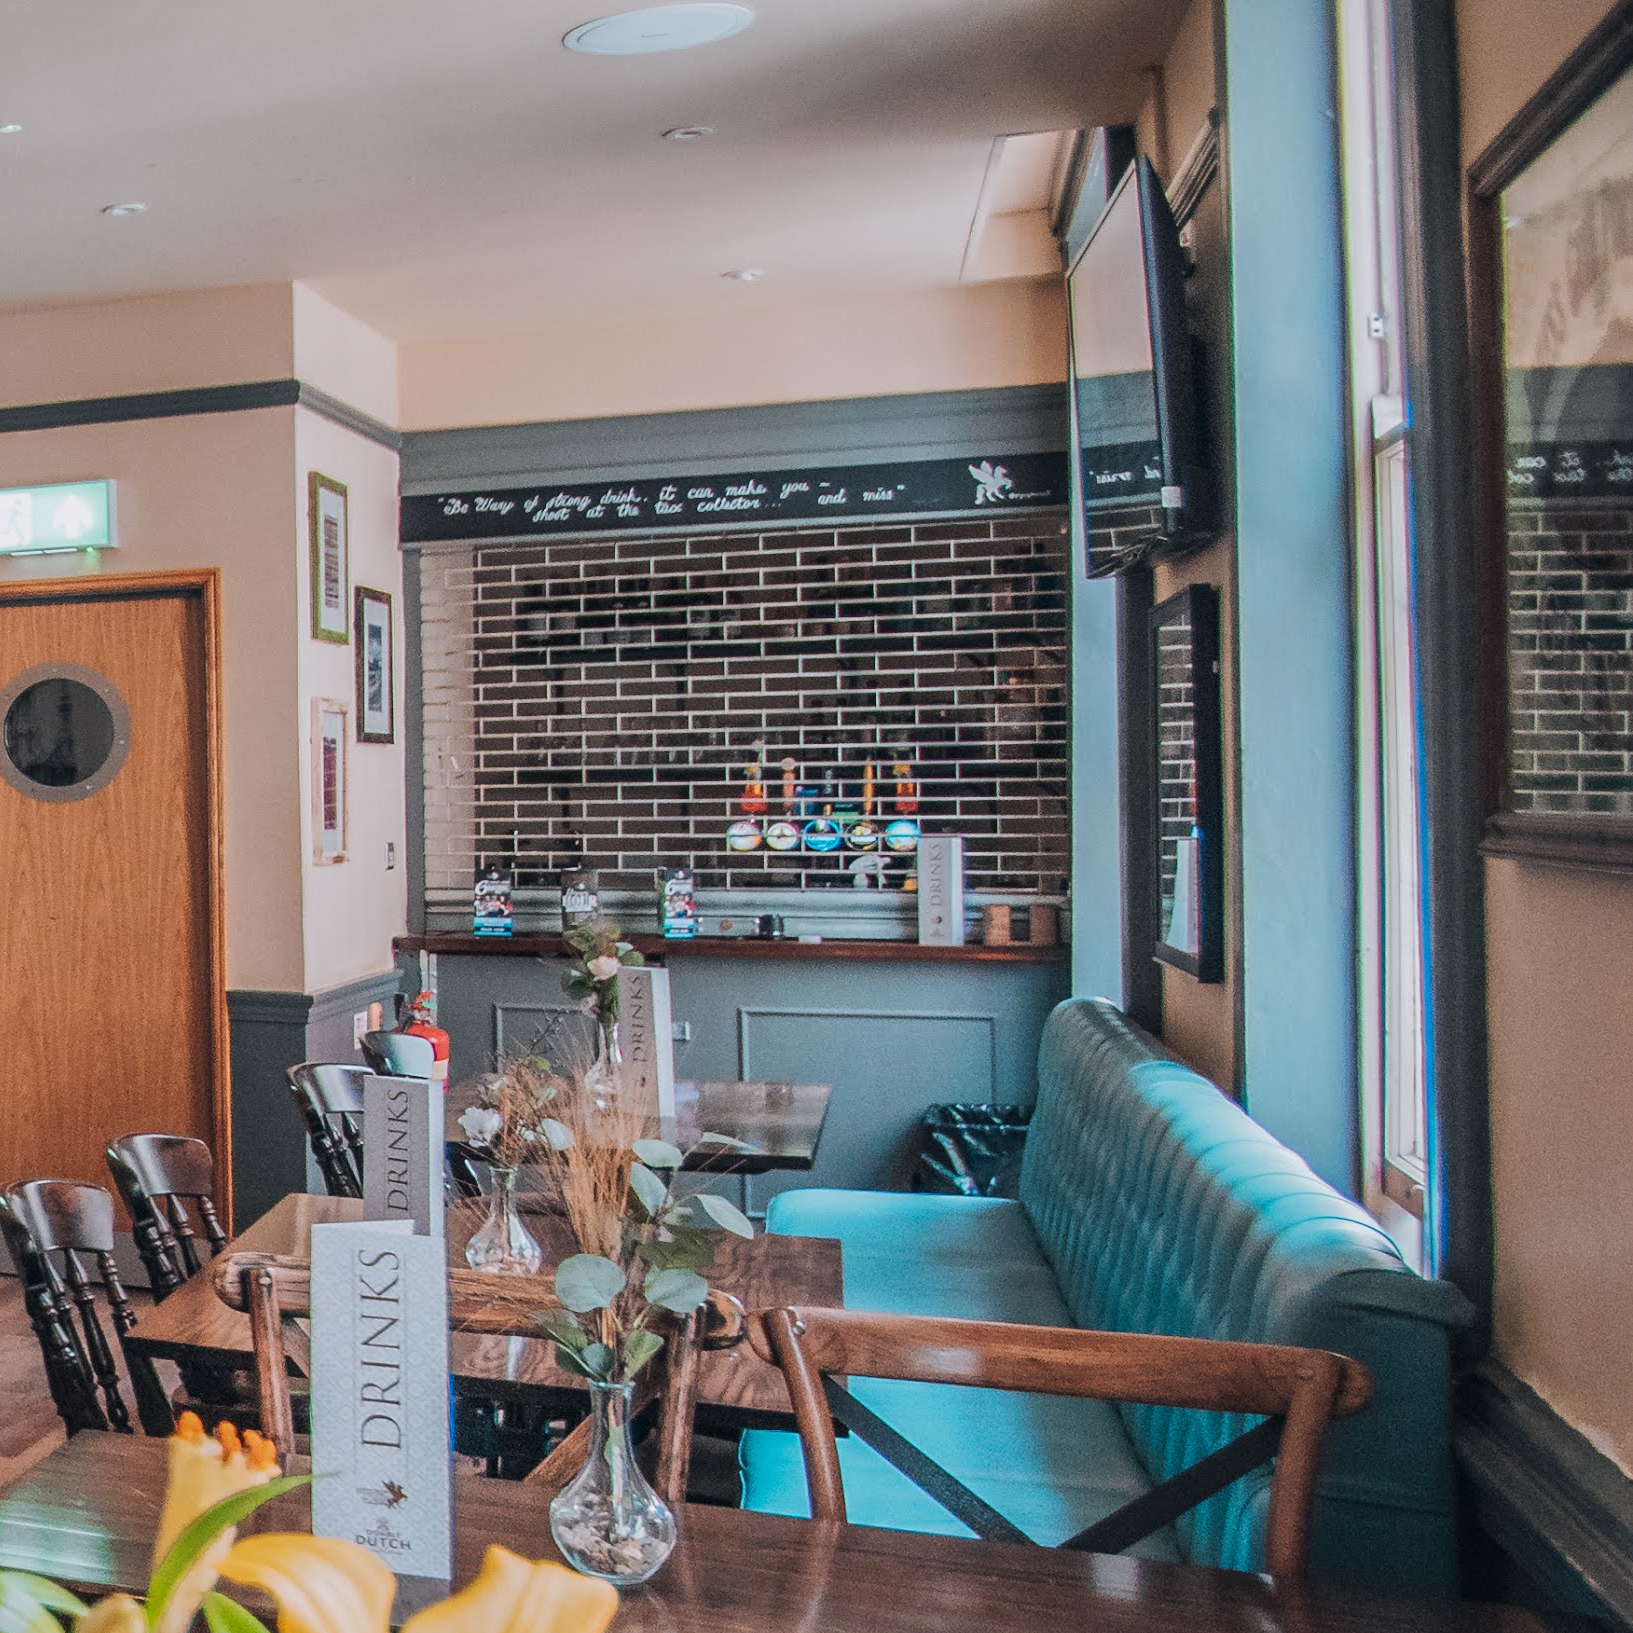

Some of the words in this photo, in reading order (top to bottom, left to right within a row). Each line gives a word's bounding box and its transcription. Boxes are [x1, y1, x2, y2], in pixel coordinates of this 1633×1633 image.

[475, 496, 514, 515] Wary
[524, 494, 538, 513] of
[546, 491, 591, 511] strong
[687, 487, 714, 499] can
[726, 479, 767, 496] make
[780, 481, 810, 499] you
[533, 508, 571, 522] shoot
[587, 505, 606, 518] at
[617, 502, 639, 518] the
[653, 501, 683, 514] tax
[818, 488, 847, 505] and
[630, 976, 648, 1063] DRINKS
[387, 1090, 409, 1212] DRINKS
[358, 1250, 402, 1450] DRINKS
[355, 1535, 411, 1551] DUTCH
